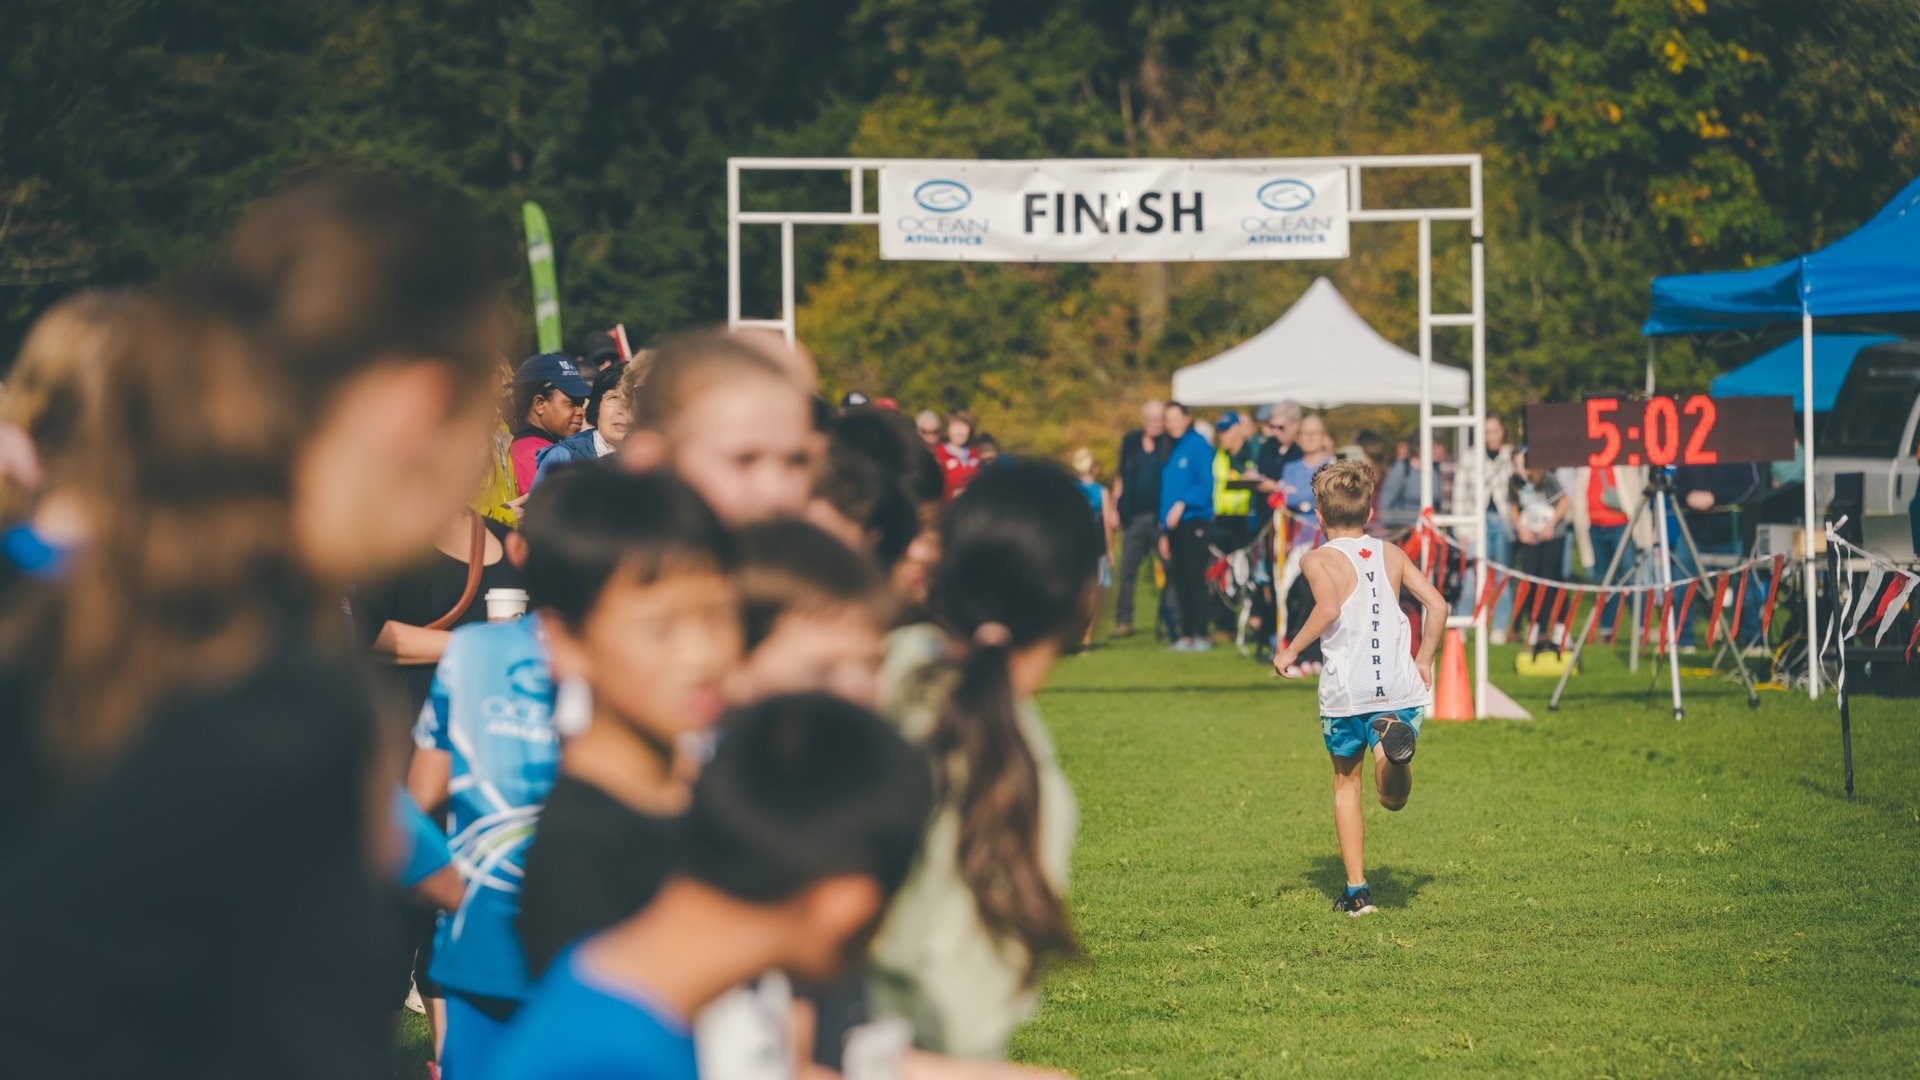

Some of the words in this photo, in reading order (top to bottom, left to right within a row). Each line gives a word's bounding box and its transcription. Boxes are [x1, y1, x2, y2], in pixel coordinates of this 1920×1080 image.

[1024, 192, 1204, 233] FINISH
[897, 216, 989, 234] OCEAN
[1240, 215, 1333, 233] OCEAN
[905, 234, 983, 245] ATHLETICS
[1248, 233, 1326, 244] ATHLETICS
[1586, 395, 1718, 467] 5:02
[1364, 571, 1386, 698] VICTORIA
